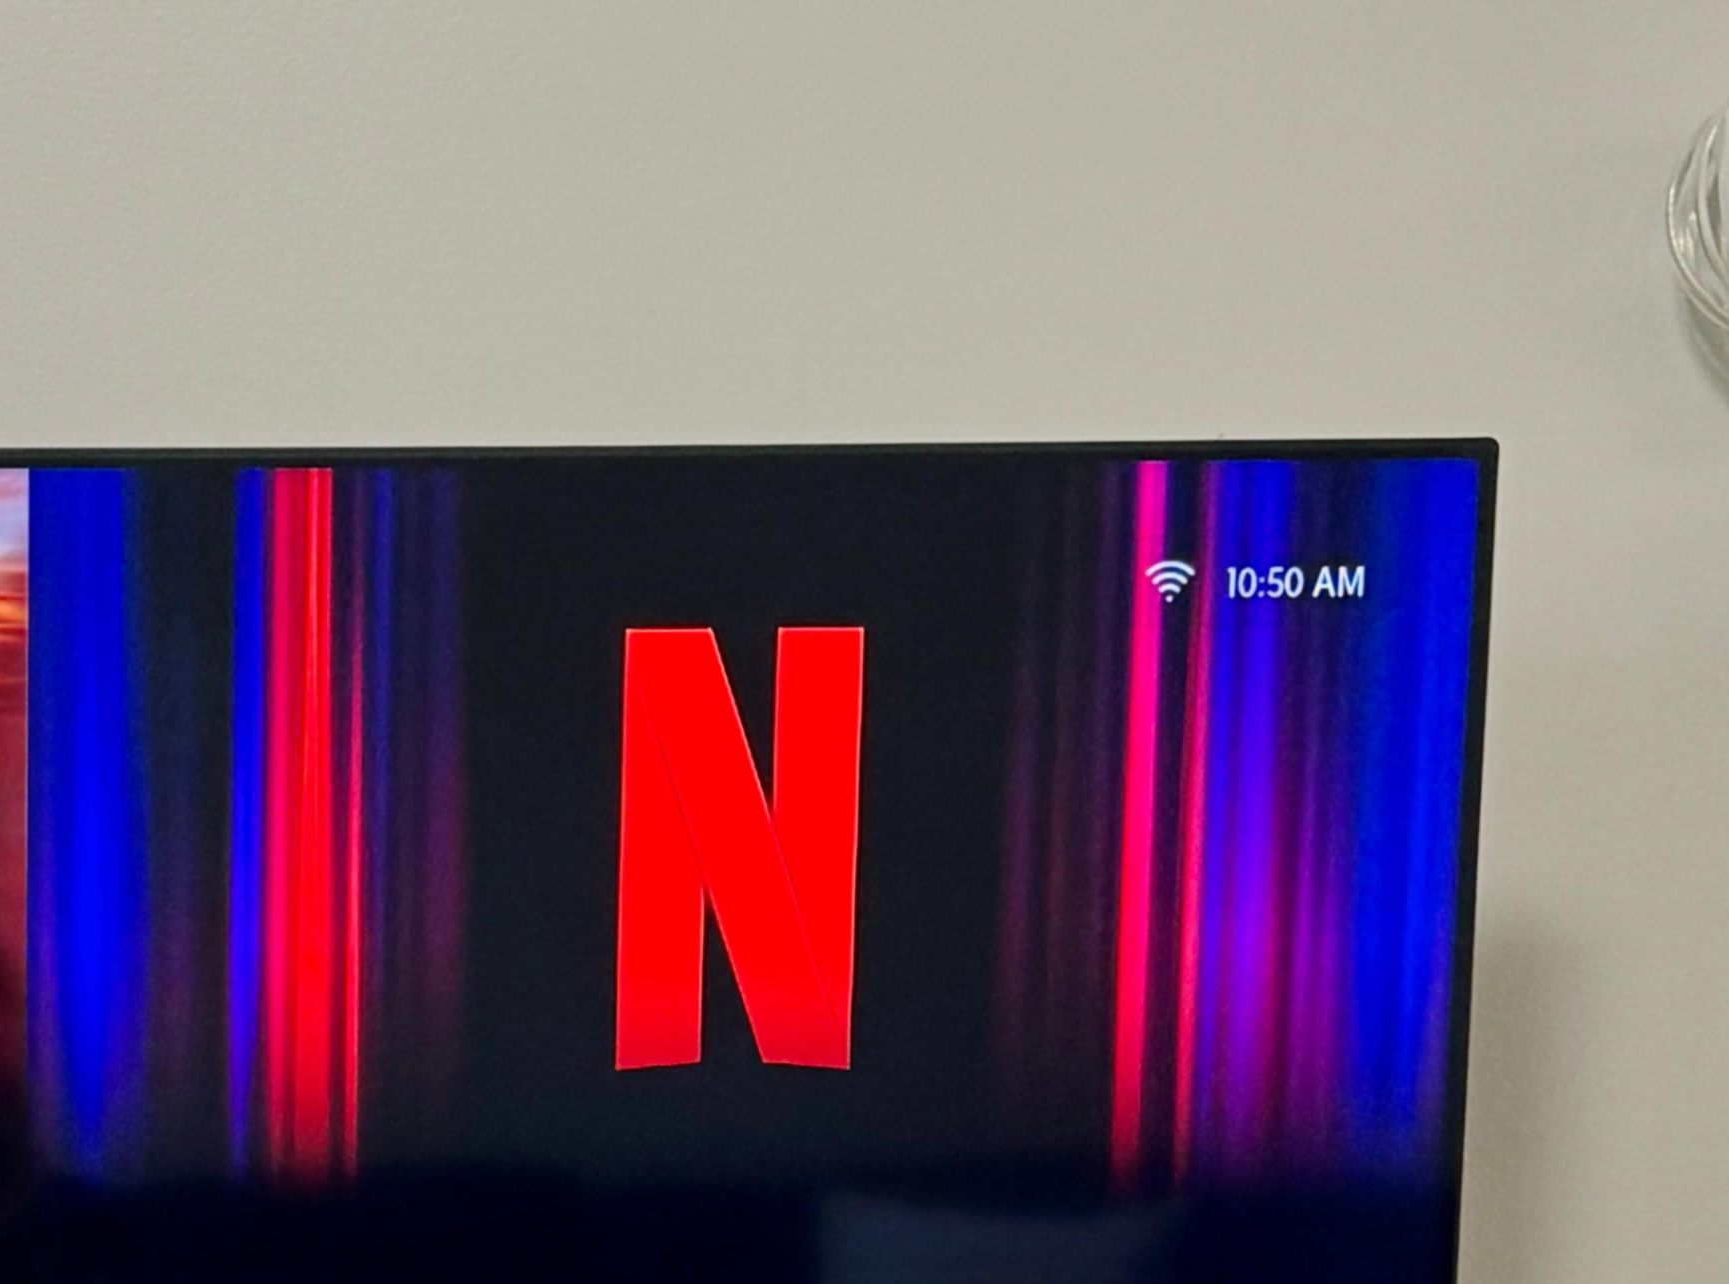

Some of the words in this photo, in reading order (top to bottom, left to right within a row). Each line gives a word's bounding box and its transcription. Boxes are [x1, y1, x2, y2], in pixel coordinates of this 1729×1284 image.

[1227, 566, 1304, 599] 10:50
[1312, 565, 1366, 599] AM
[615, 626, 865, 1071] N
